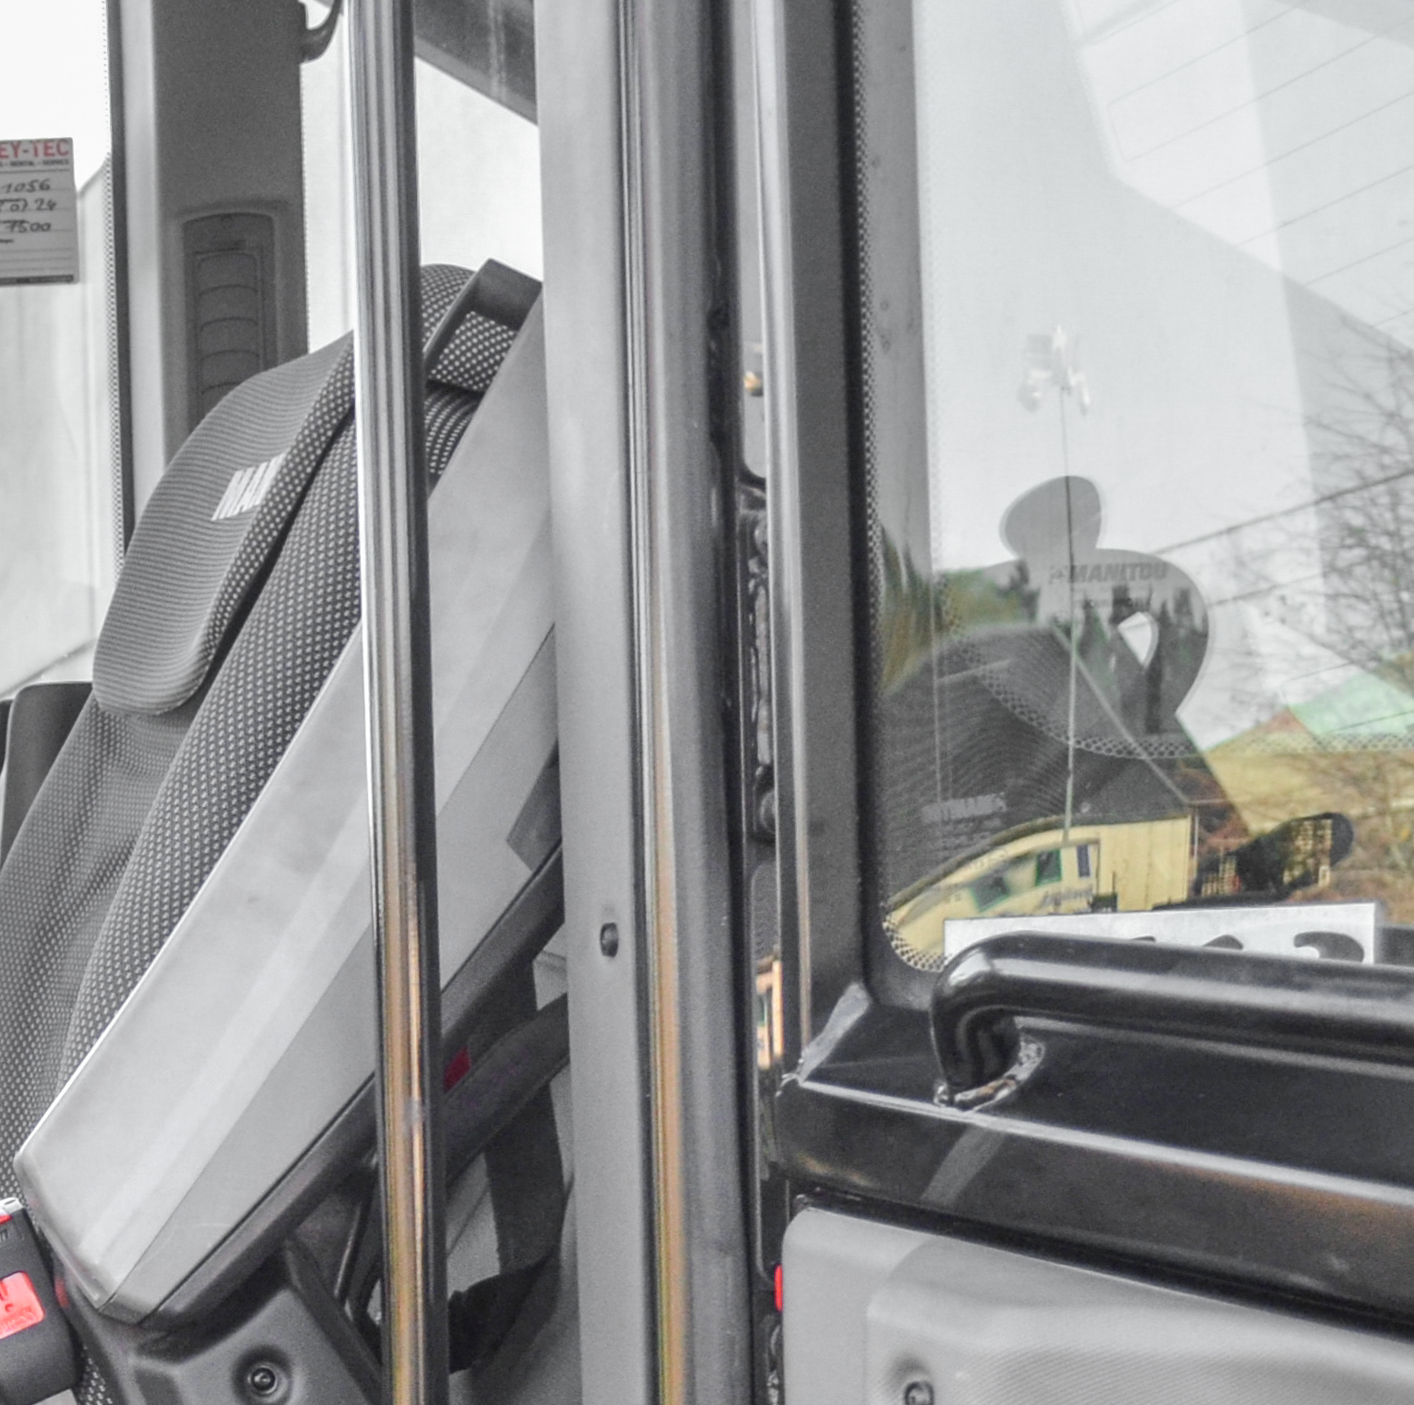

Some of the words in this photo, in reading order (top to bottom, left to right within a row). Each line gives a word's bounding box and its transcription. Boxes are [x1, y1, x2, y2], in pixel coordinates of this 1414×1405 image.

[0, 178, 51, 193] 1056
[34, 198, 57, 211] 24
[1069, 562, 1168, 583] MANITOU
